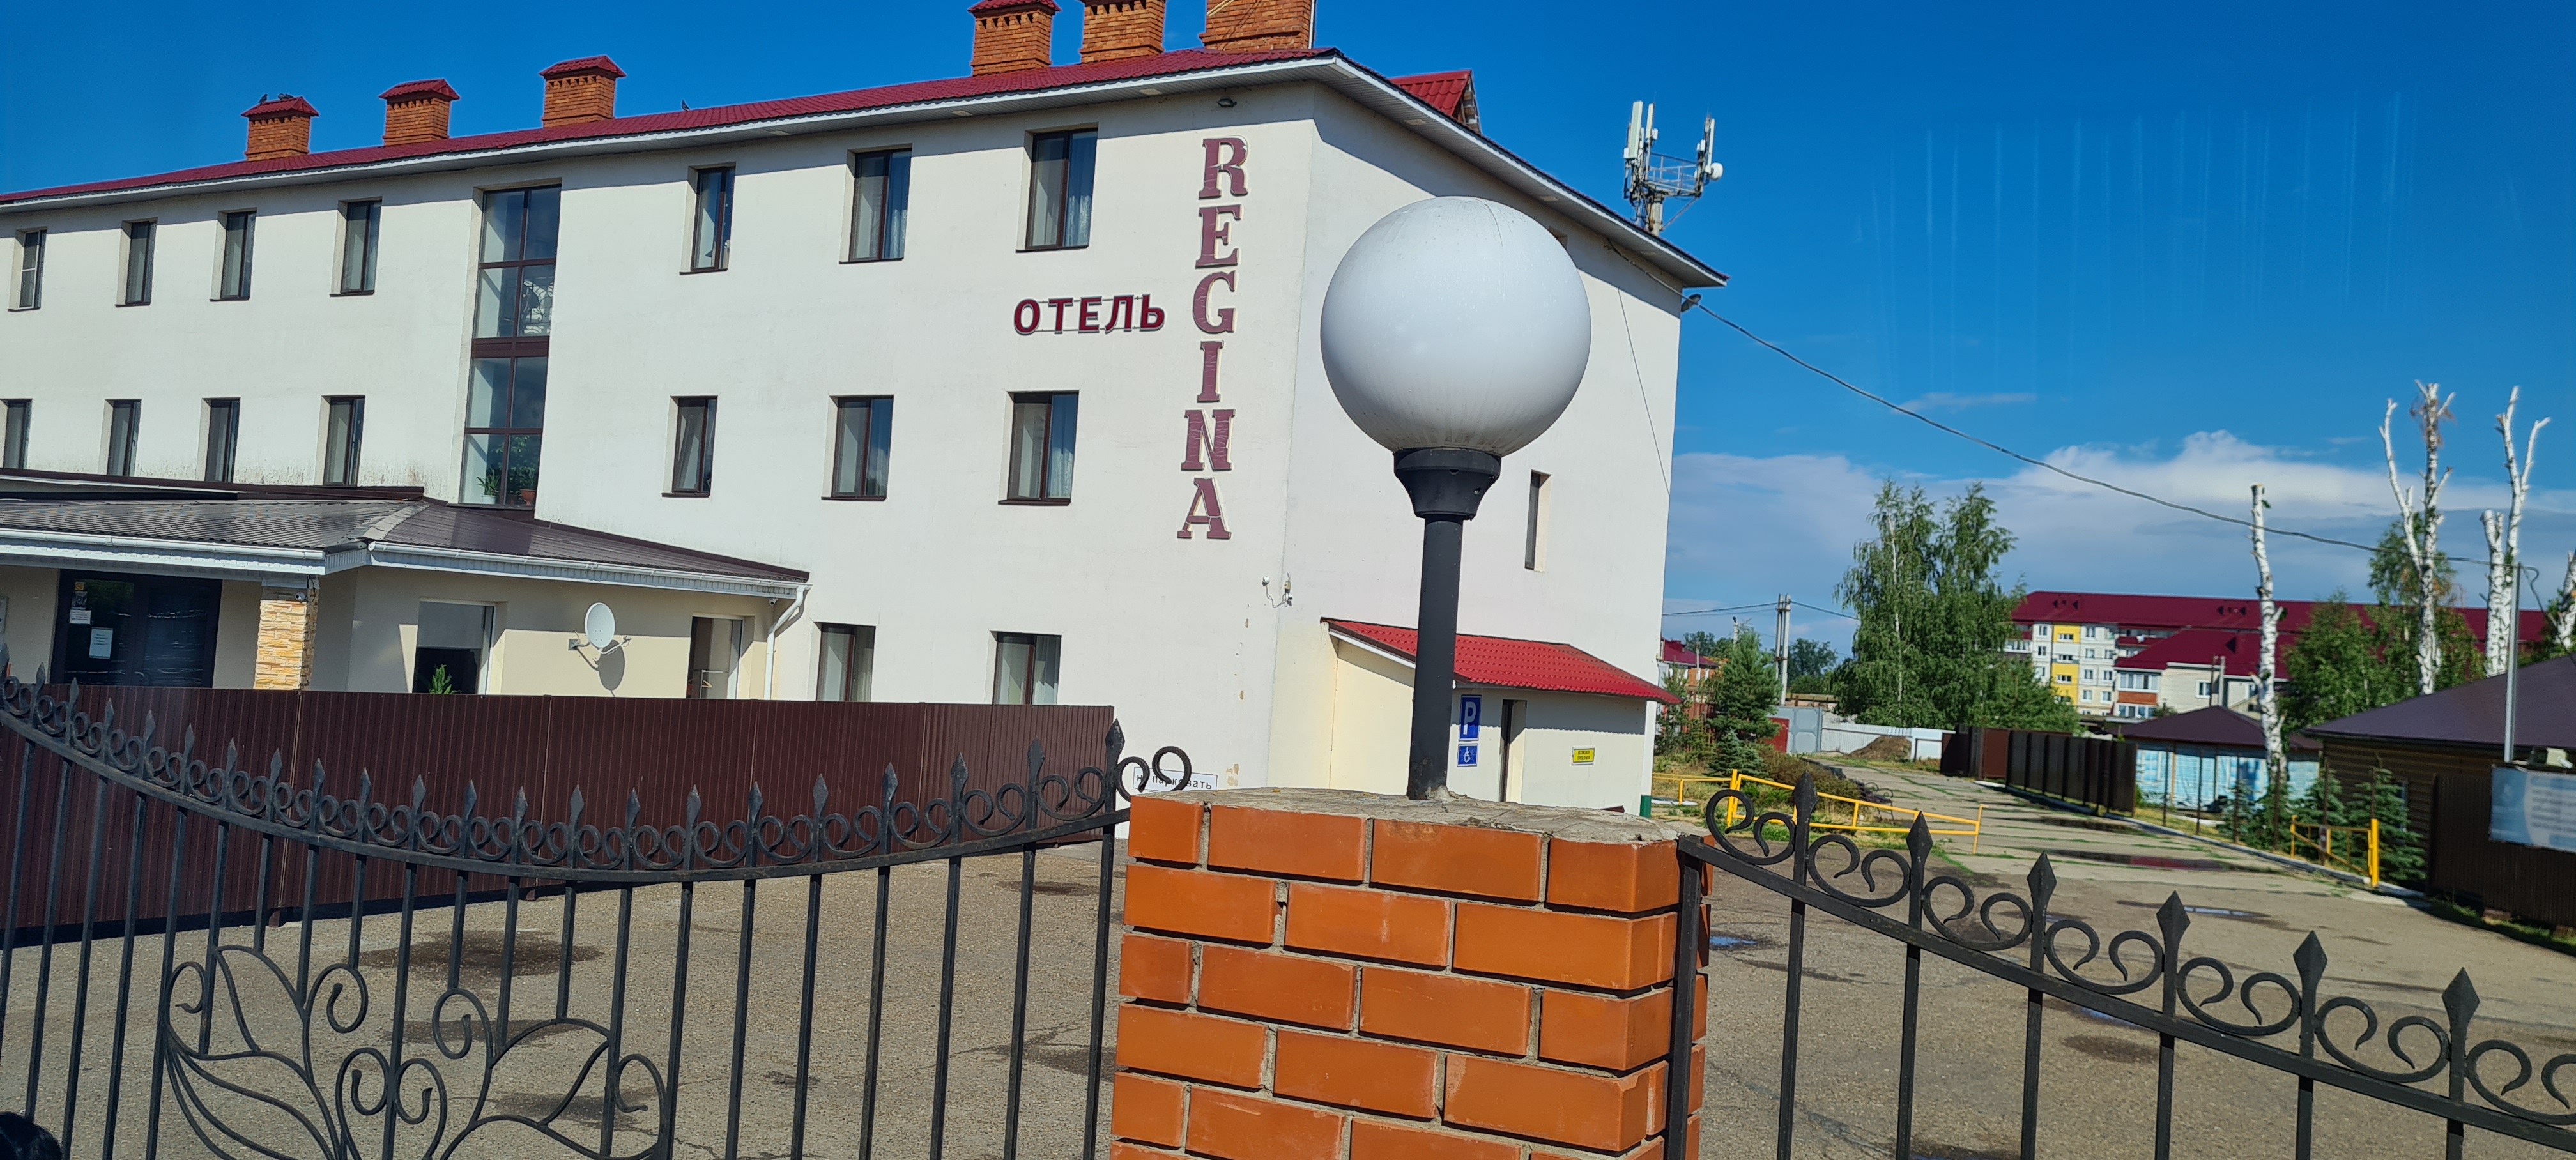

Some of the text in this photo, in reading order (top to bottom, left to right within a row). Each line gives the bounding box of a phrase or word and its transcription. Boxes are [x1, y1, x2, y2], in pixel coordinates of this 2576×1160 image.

[1014, 294, 1165, 335] ОТЕЛЬ
[1177, 136, 1248, 540] REGINA
[1463, 701, 1476, 735] P
